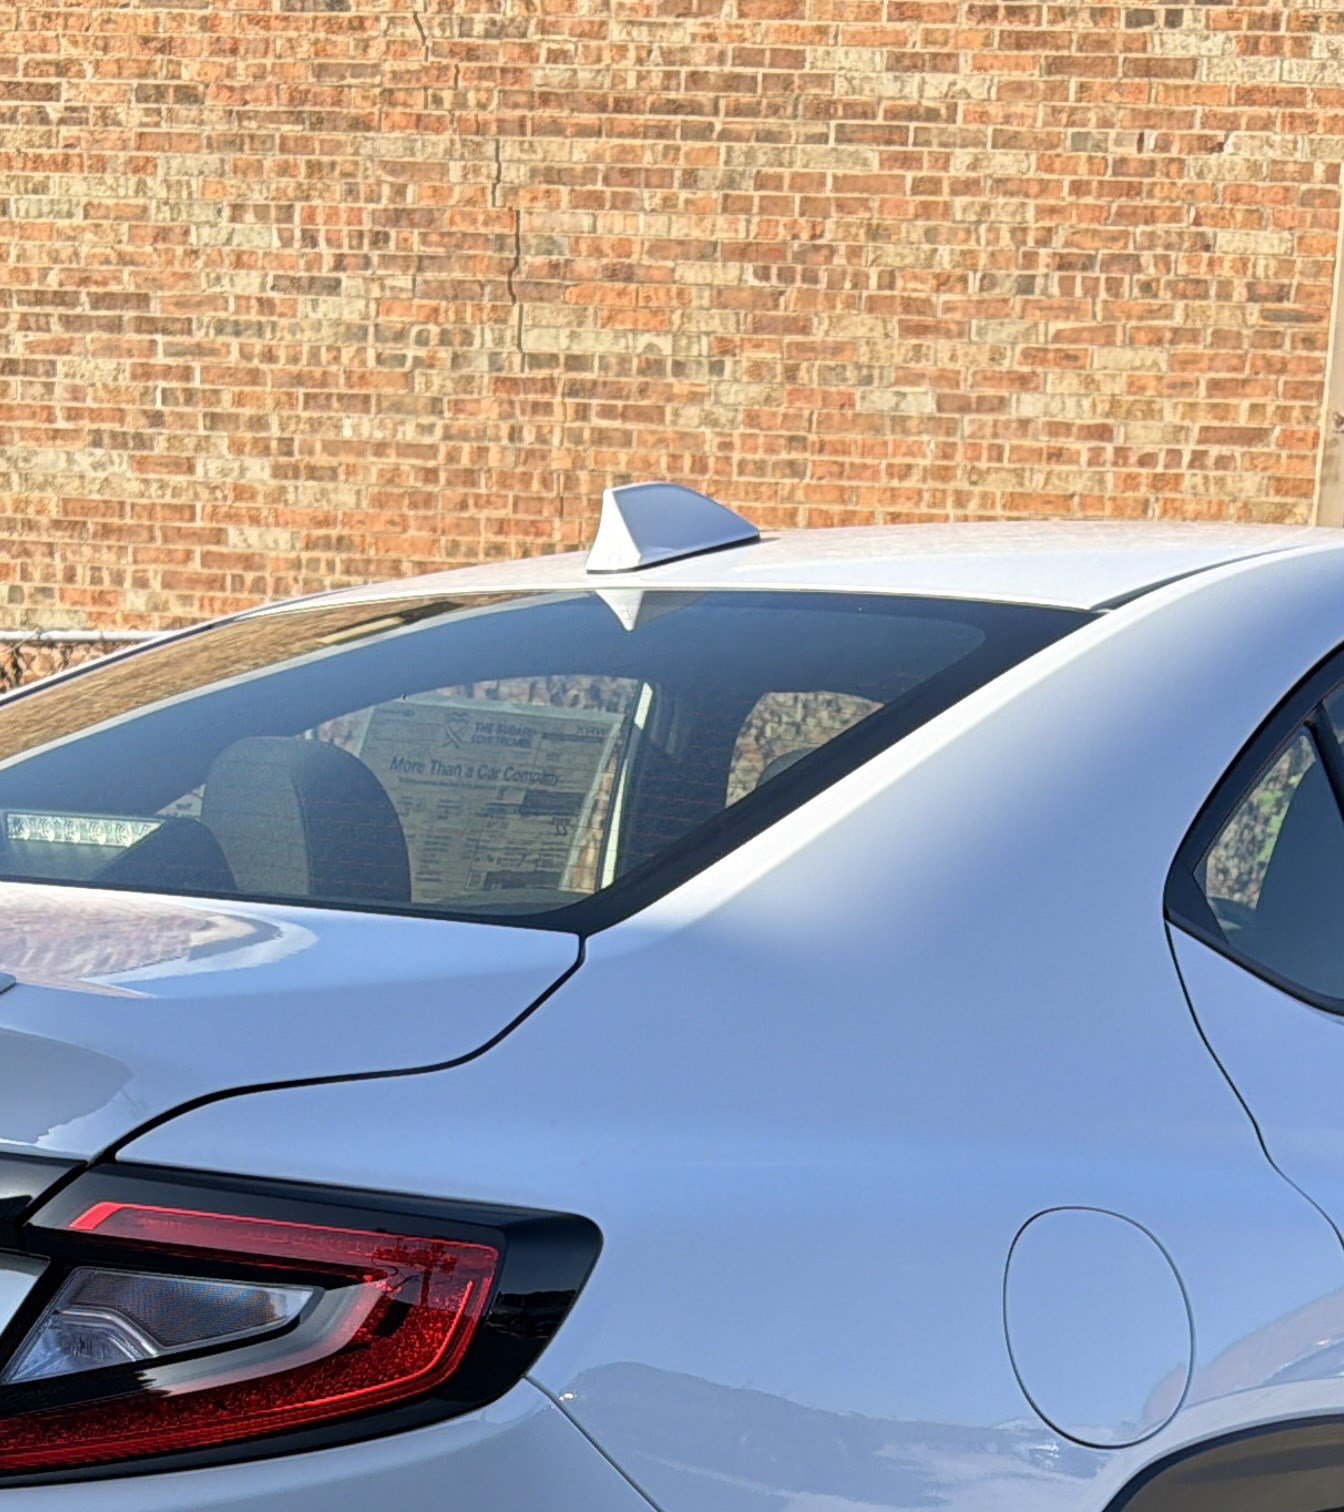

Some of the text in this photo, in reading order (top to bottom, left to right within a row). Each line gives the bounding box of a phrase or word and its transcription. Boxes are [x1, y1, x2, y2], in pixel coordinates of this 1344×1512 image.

[389, 754, 425, 774] More
[430, 758, 462, 778] Than
[465, 764, 473, 779] a
[477, 762, 502, 782] Car
